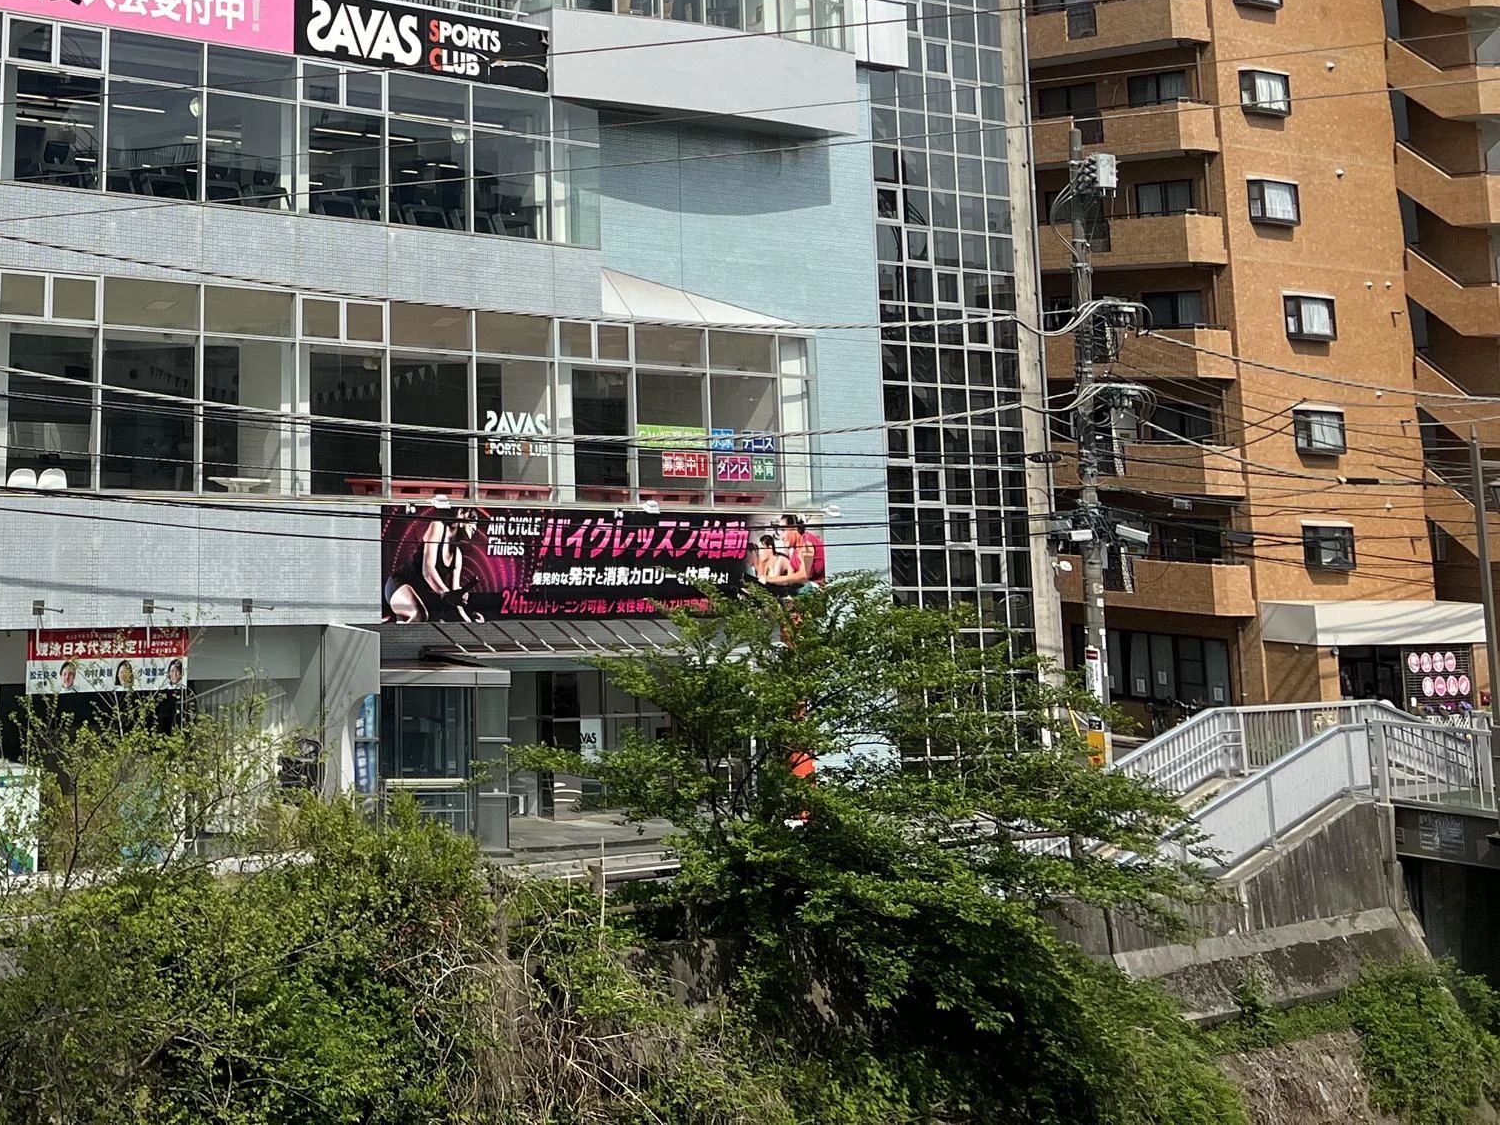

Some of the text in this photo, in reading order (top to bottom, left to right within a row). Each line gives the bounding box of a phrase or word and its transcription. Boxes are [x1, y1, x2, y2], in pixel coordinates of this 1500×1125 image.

[428, 19, 502, 53] SPORTS
[428, 47, 481, 76] CLUB
[484, 410, 549, 441] SAVAS
[717, 457, 750, 475] ダンス
[487, 516, 541, 535] AIR CYCLE
[539, 518, 749, 559] バイクレッスン始動
[487, 537, 524, 556] Fitness
